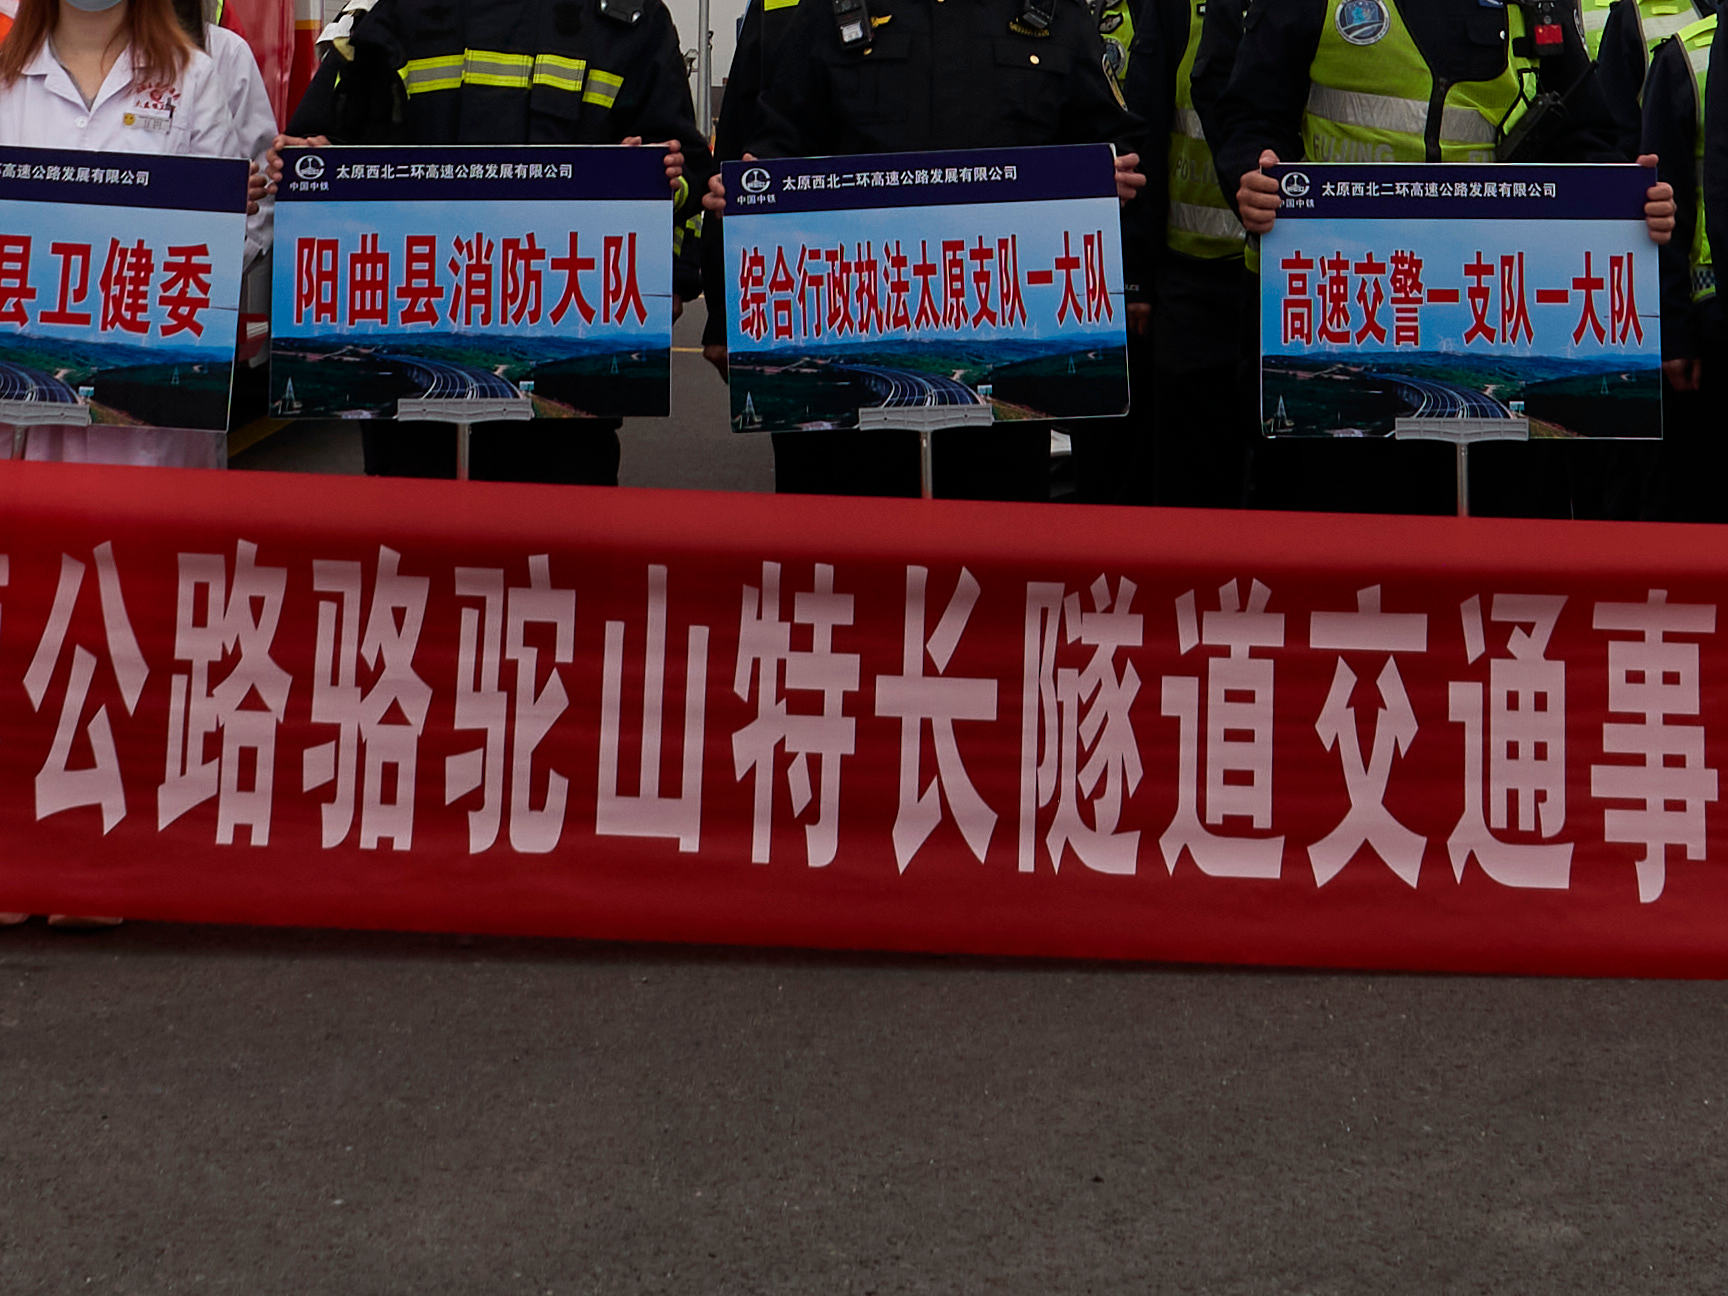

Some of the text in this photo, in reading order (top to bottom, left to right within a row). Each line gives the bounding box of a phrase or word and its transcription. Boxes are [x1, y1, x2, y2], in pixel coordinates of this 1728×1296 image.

[294, 231, 648, 327] 阳曲县消防大队
[739, 230, 1114, 342] 综合行政执法太原支队一大队
[1280, 249, 1645, 347] 高速交警一支队一大队
